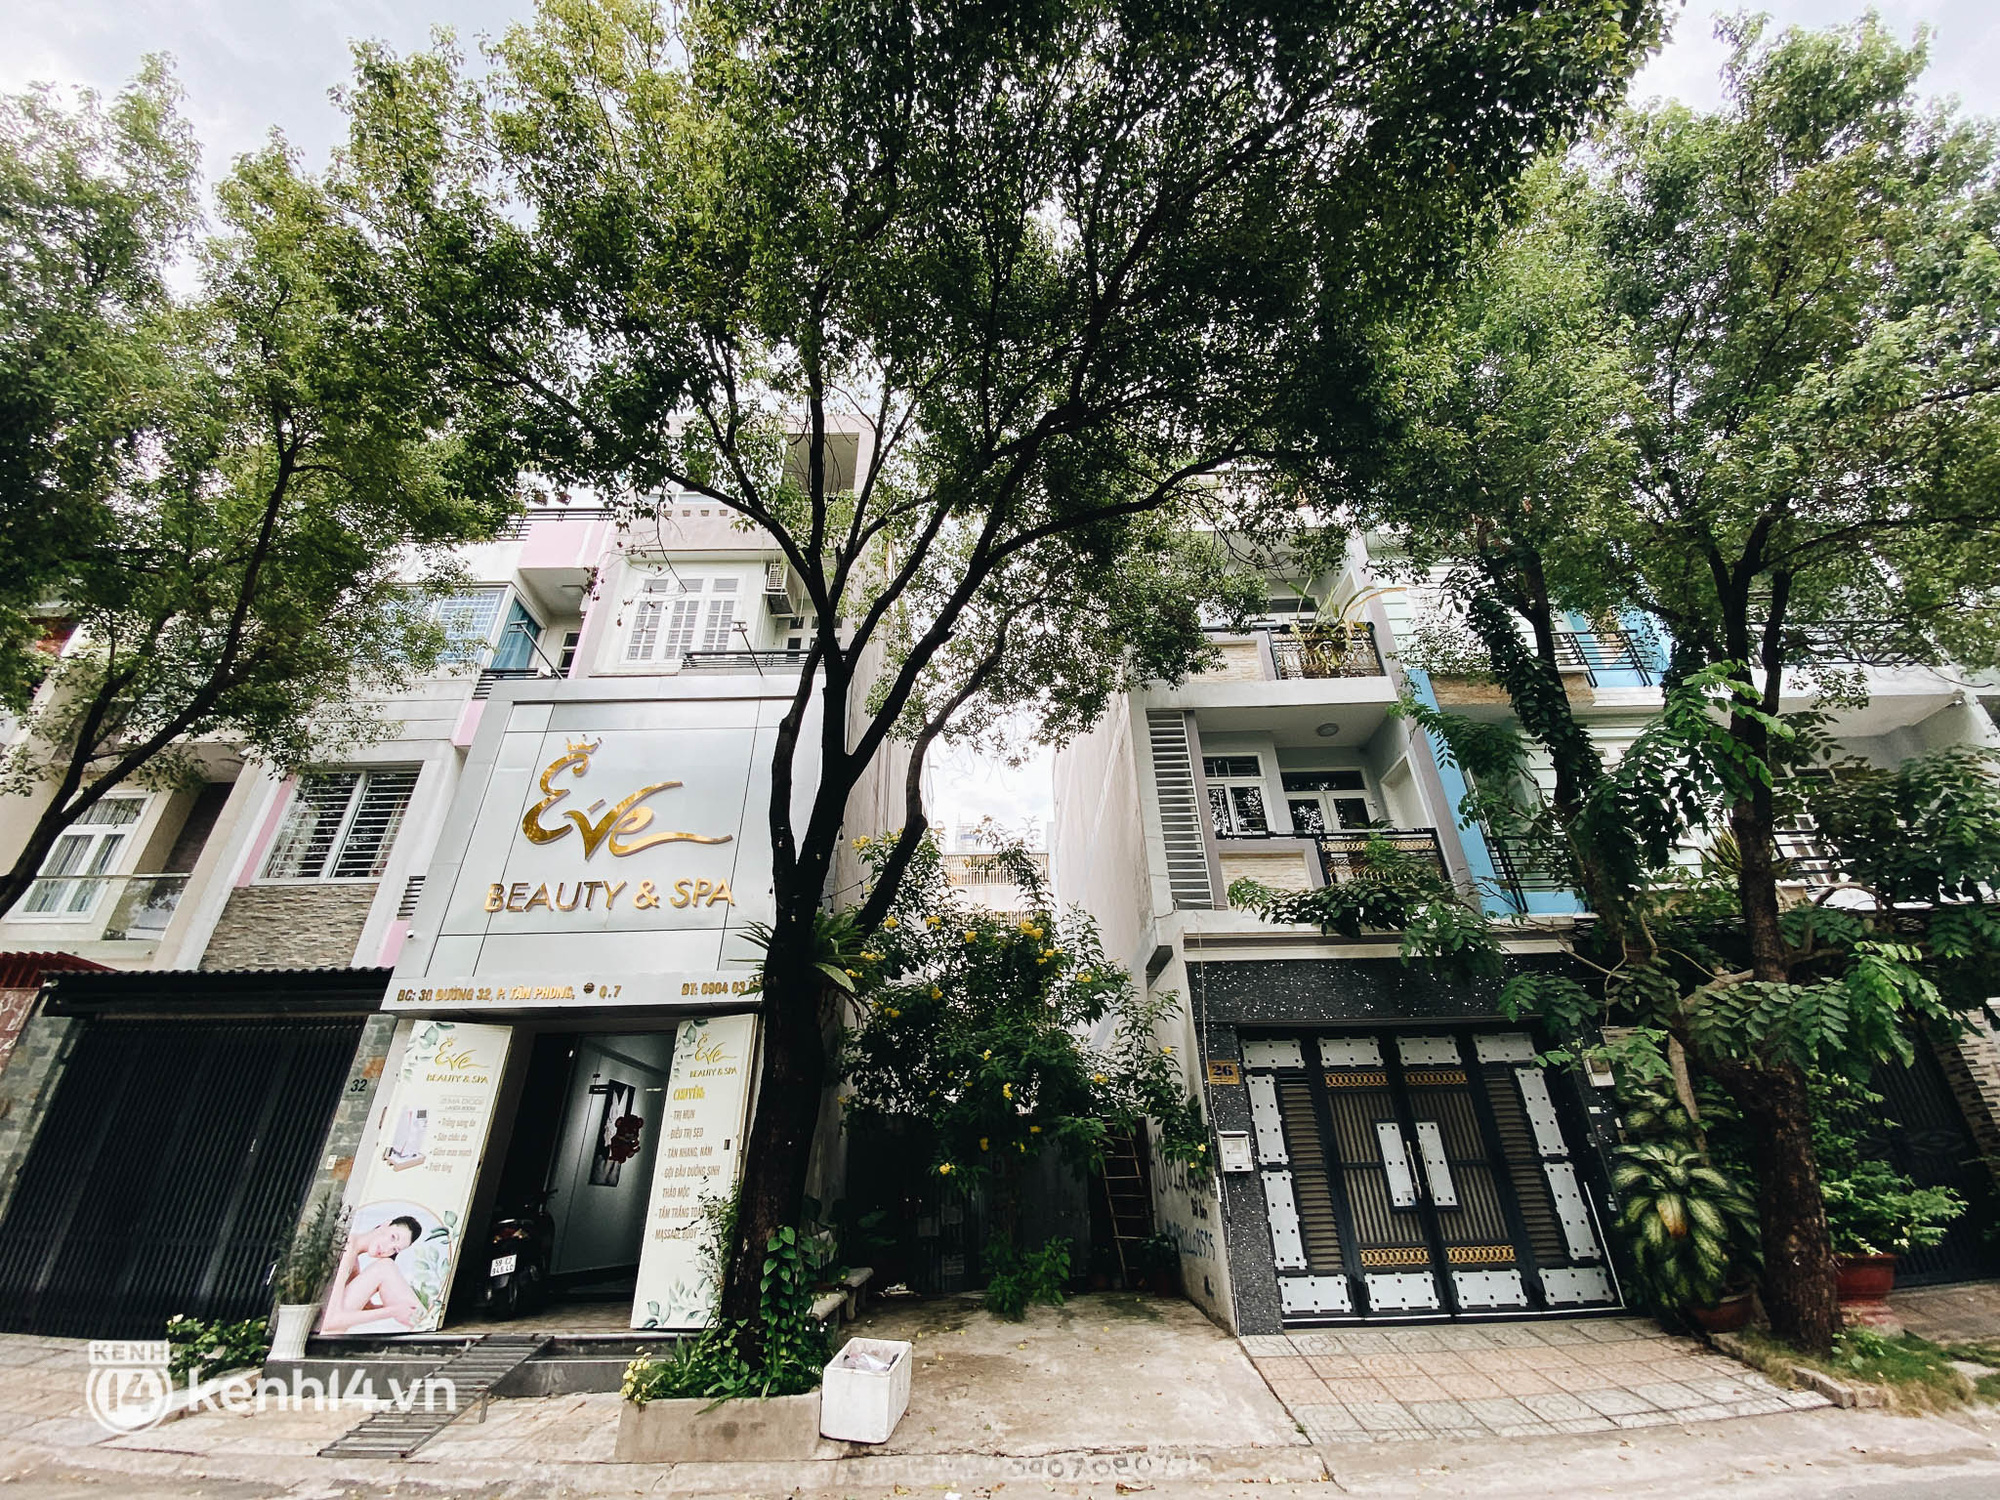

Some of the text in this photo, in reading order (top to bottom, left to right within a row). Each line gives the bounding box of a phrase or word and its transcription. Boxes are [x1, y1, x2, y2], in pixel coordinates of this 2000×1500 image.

[522, 752, 733, 861] Eve
[484, 877, 736, 913] BEAUTY & SPA
[690, 1069, 716, 1078] BEAUTY
[725, 1067, 737, 1075] SPA
[1212, 1065, 1234, 1076] 26
[426, 1073, 462, 1083] BEAUTY
[471, 1075, 488, 1084] SPA
[351, 1079, 367, 1092] 32
